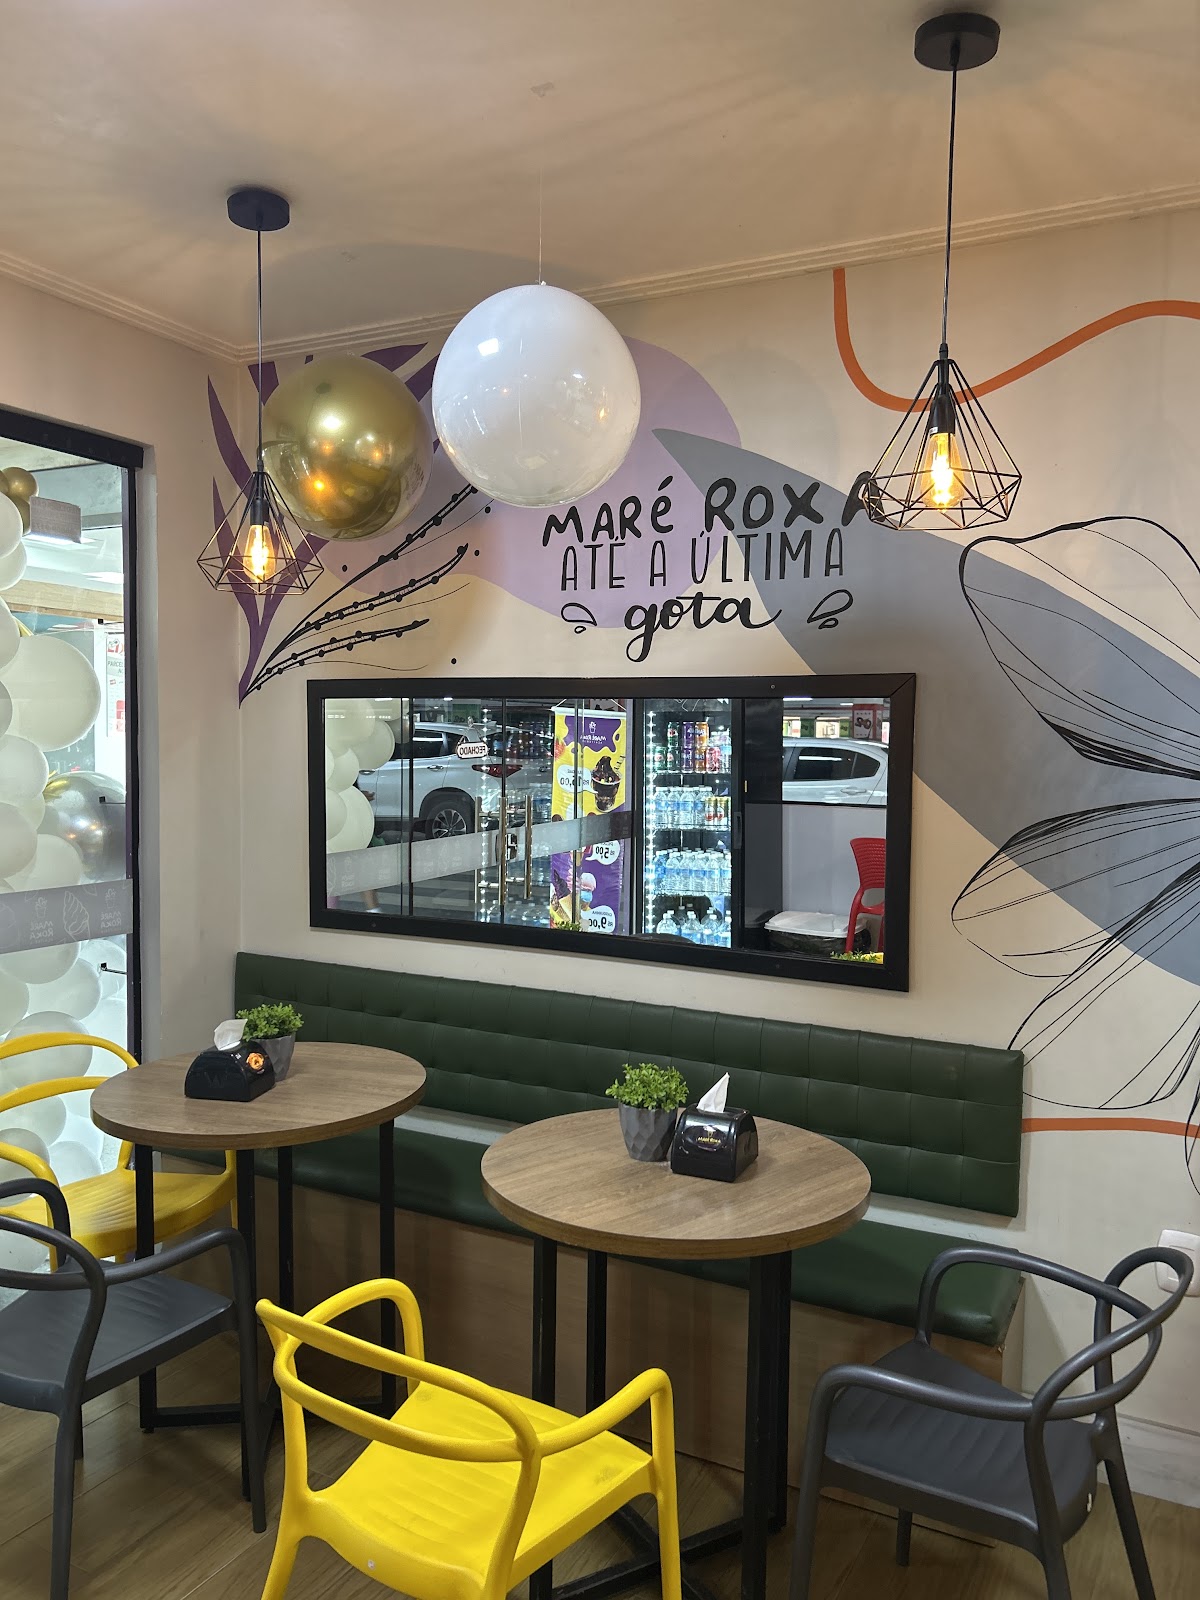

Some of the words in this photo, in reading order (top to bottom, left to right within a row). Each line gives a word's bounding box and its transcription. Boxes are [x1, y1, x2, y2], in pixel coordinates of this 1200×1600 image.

[560, 537, 626, 591] ATÉ
[649, 540, 667, 587] A
[690, 527, 844, 585] ÚLTIMA
[624, 591, 783, 663] gota
